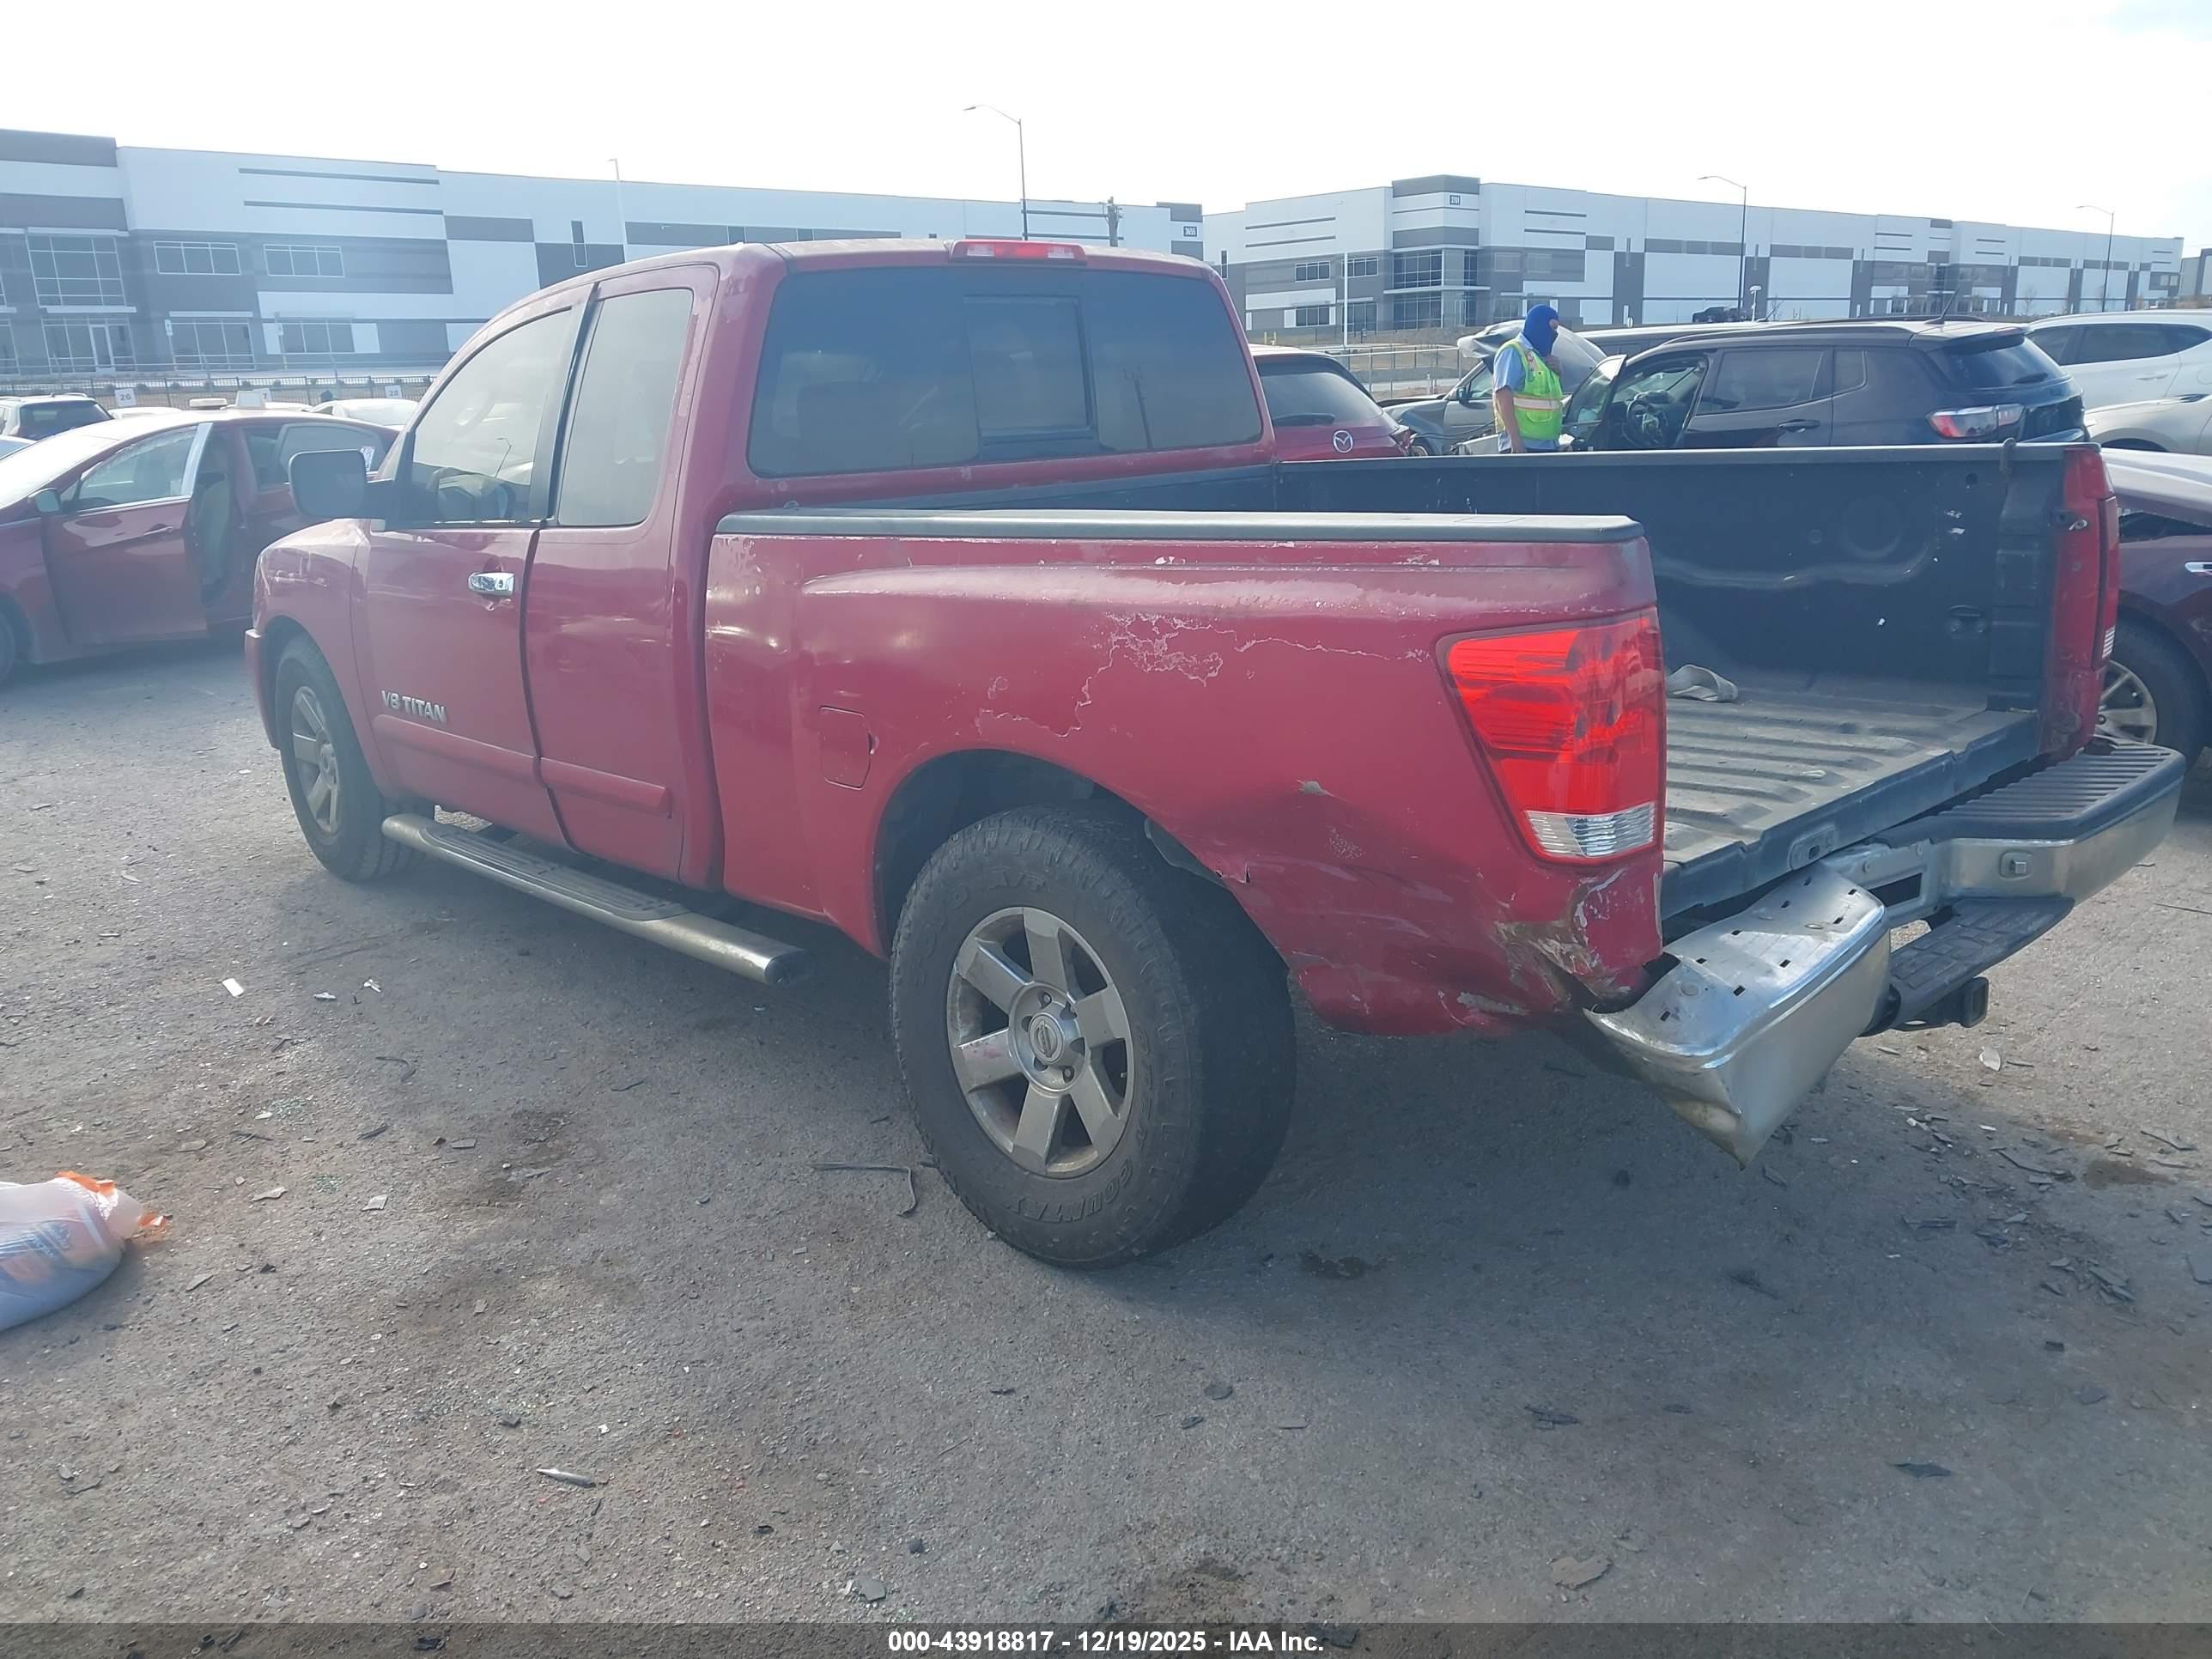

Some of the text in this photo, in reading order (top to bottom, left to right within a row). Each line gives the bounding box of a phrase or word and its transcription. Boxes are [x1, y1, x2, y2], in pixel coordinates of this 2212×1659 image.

[381, 690, 447, 722] V8 TITAN
[1002, 1156, 1133, 1224] COUNTRY
